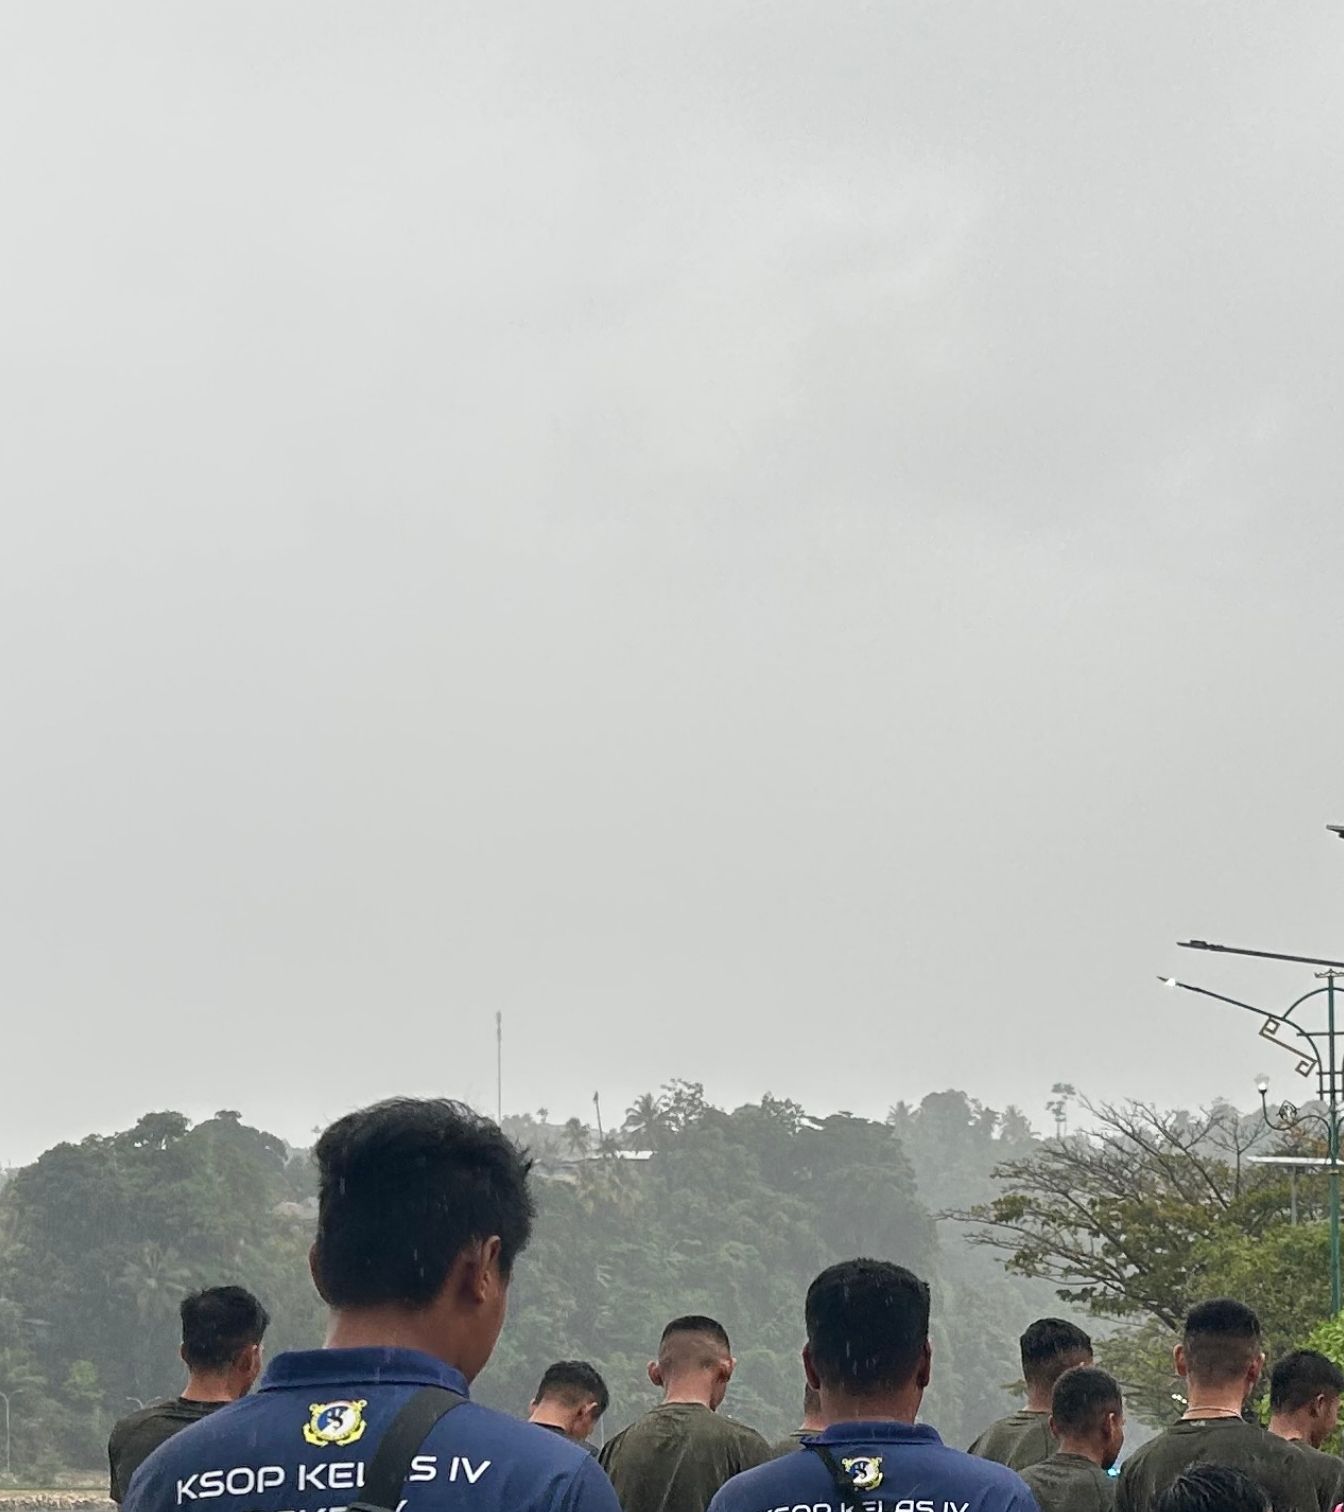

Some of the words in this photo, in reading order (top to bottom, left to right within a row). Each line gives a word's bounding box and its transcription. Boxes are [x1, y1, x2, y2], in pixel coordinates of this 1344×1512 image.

[176, 1466, 286, 1505] KSOP
[297, 1454, 438, 1492] KELS
[447, 1455, 492, 1485] IV
